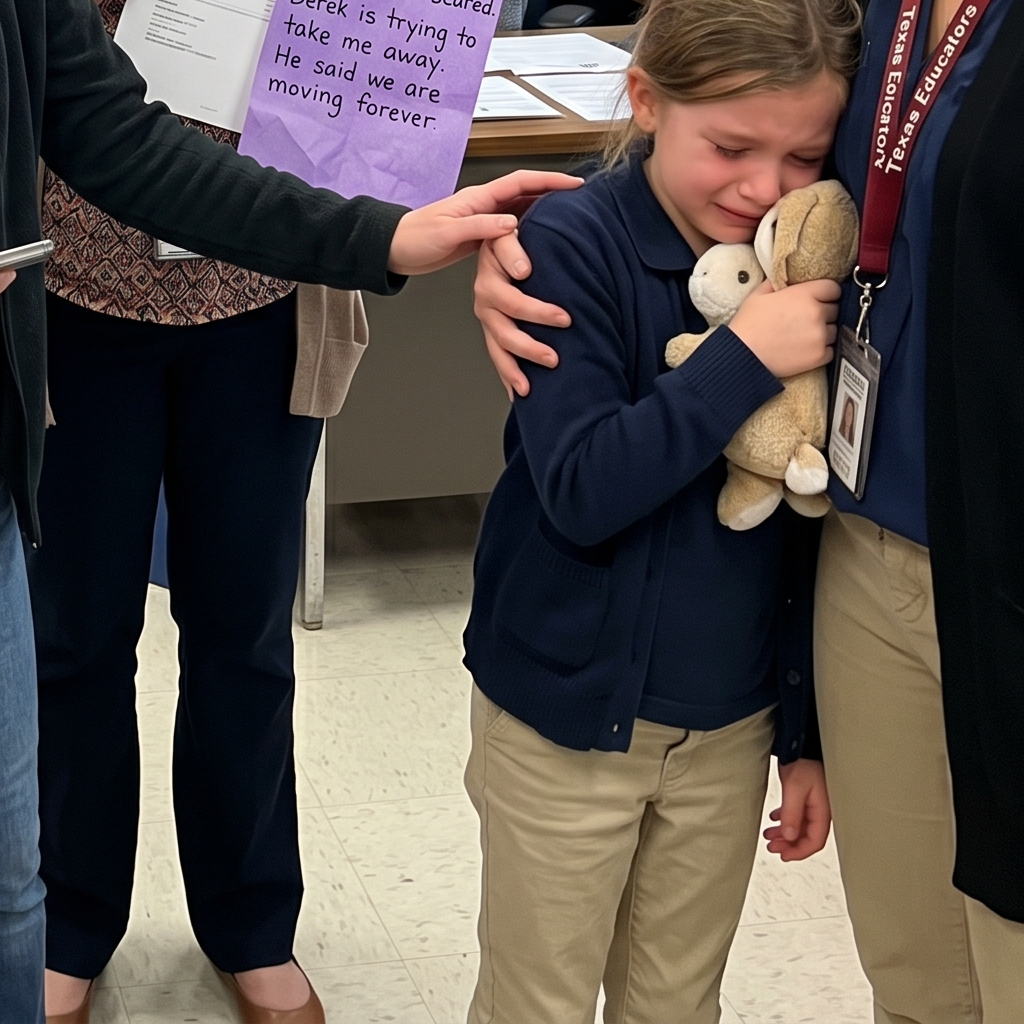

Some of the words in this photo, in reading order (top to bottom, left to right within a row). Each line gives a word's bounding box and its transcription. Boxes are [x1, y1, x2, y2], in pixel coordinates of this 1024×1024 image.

[283, 14, 331, 46] take
[341, 37, 372, 55] me
[383, 47, 446, 81] away.
[359, 6, 376, 25] is
[386, 8, 448, 53] trying
[456, 27, 477, 49] to
[891, 5, 917, 66] Texas
[268, 78, 343, 119] moving
[356, 92, 437, 130] forever.
[274, 44, 301, 69] He
[313, 61, 358, 82] said
[368, 74, 395, 91] we
[404, 84, 440, 104] are
[884, 109, 920, 174] Texas
[914, 4, 977, 106] Educators
